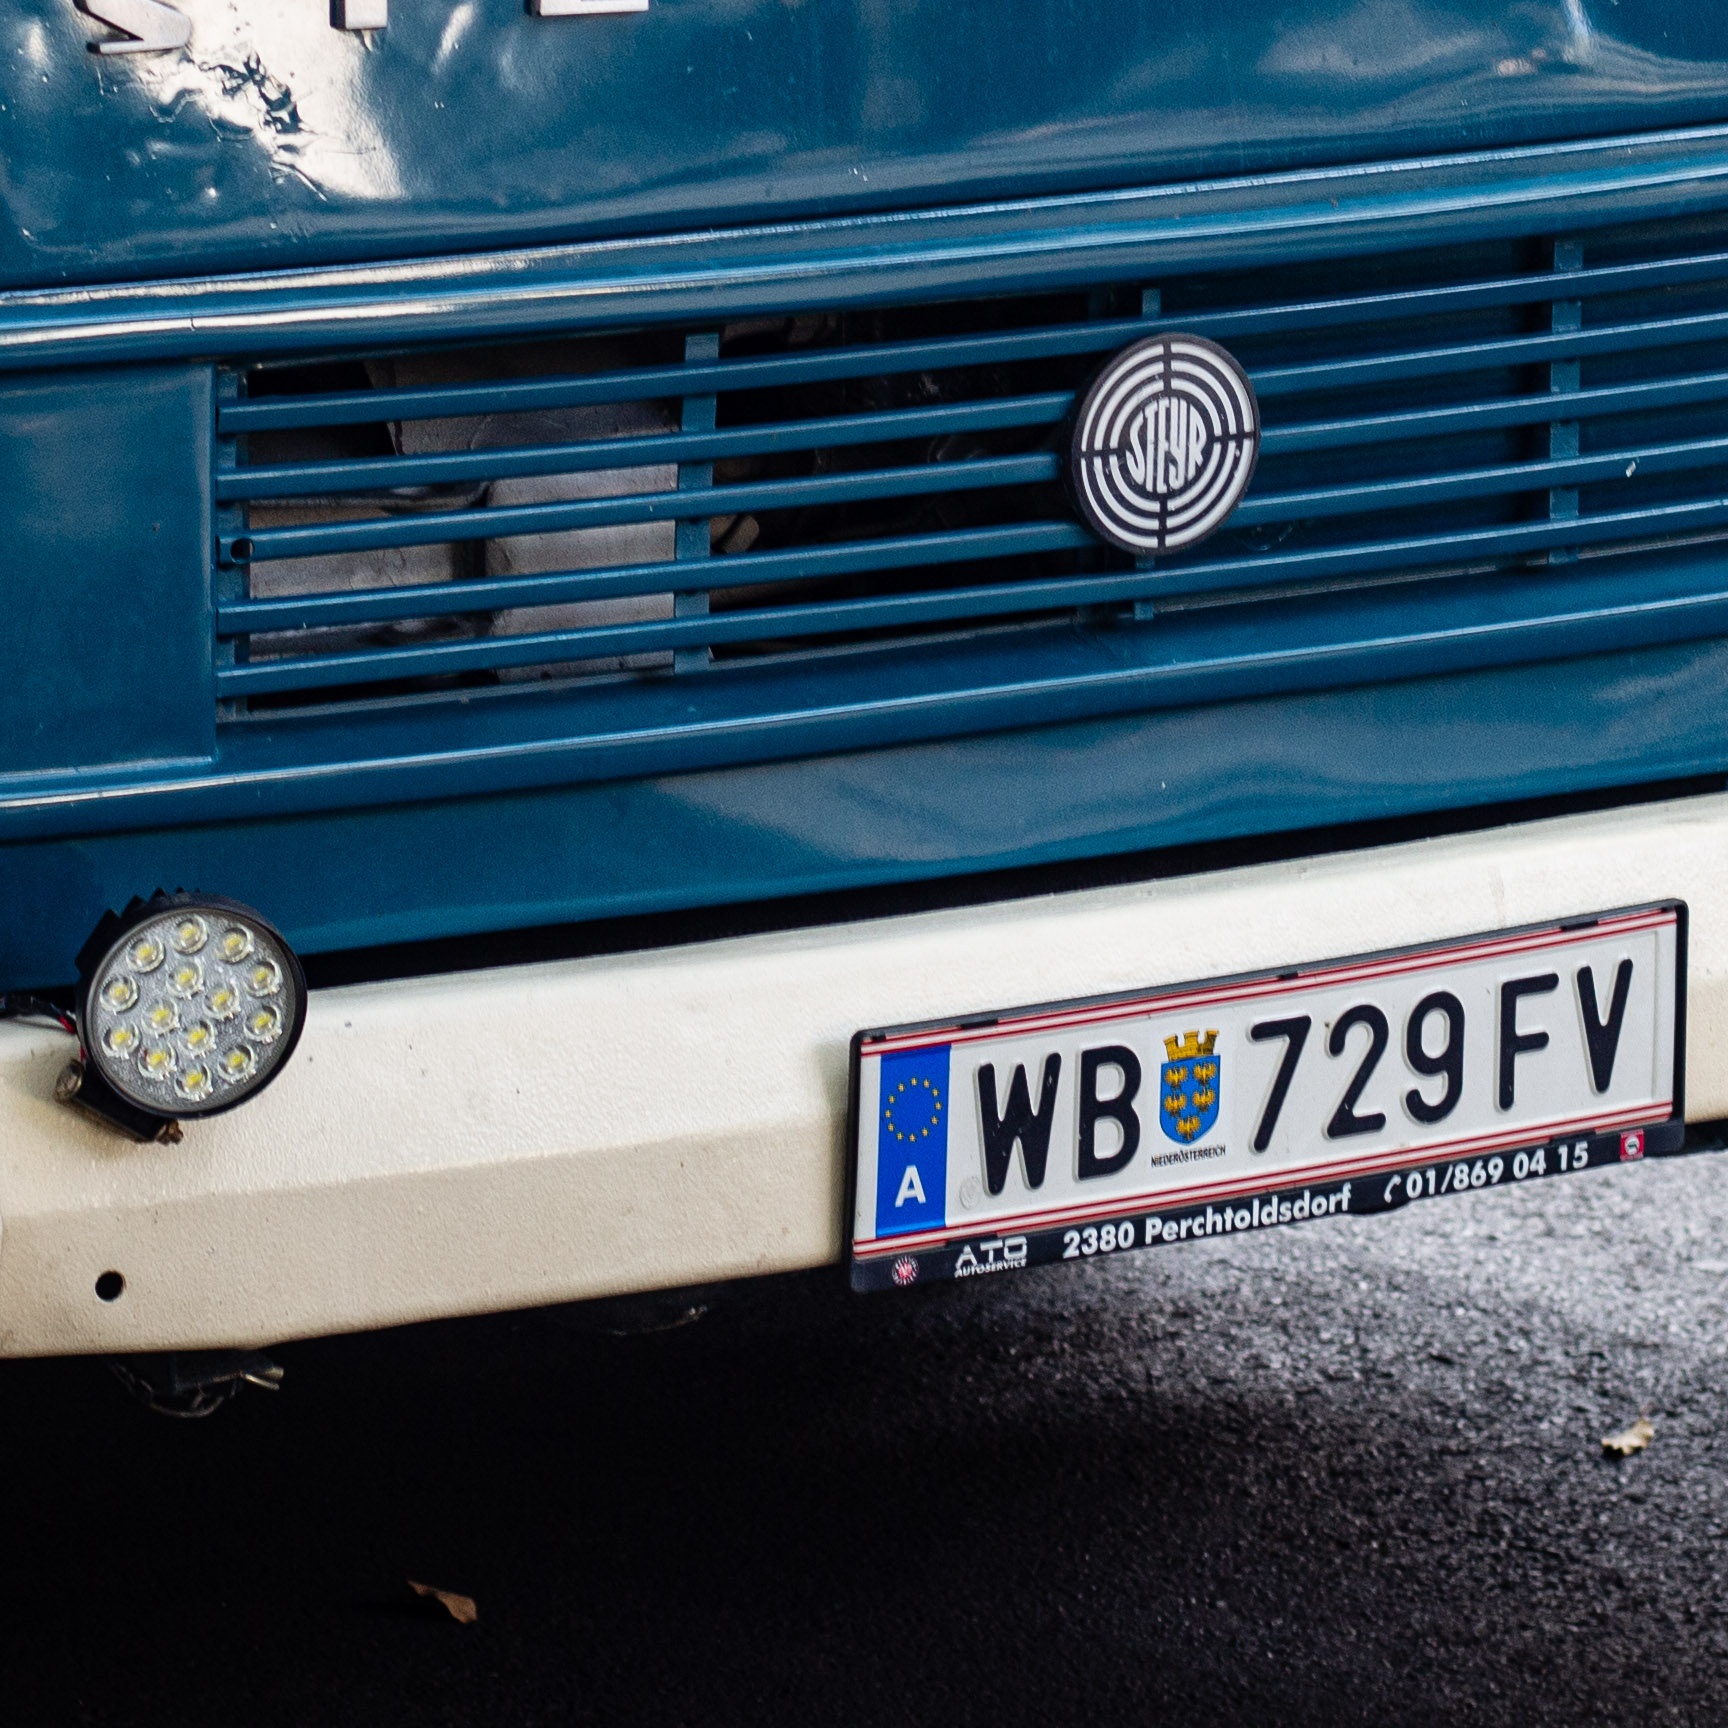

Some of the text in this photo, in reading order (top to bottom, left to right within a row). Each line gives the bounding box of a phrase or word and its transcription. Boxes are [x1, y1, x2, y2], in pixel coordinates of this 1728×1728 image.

[1125, 395, 1209, 495] STEYR
[976, 957, 1634, 1196] WB 729 FV
[894, 1164, 928, 1208] A
[1150, 1143, 1227, 1168] NIEDERÖSTERREICH
[1062, 1140, 1590, 1259] 2380 Perchtoldsdorf 01/869 04 15
[954, 1258, 1028, 1279] AUTOSERVICE
